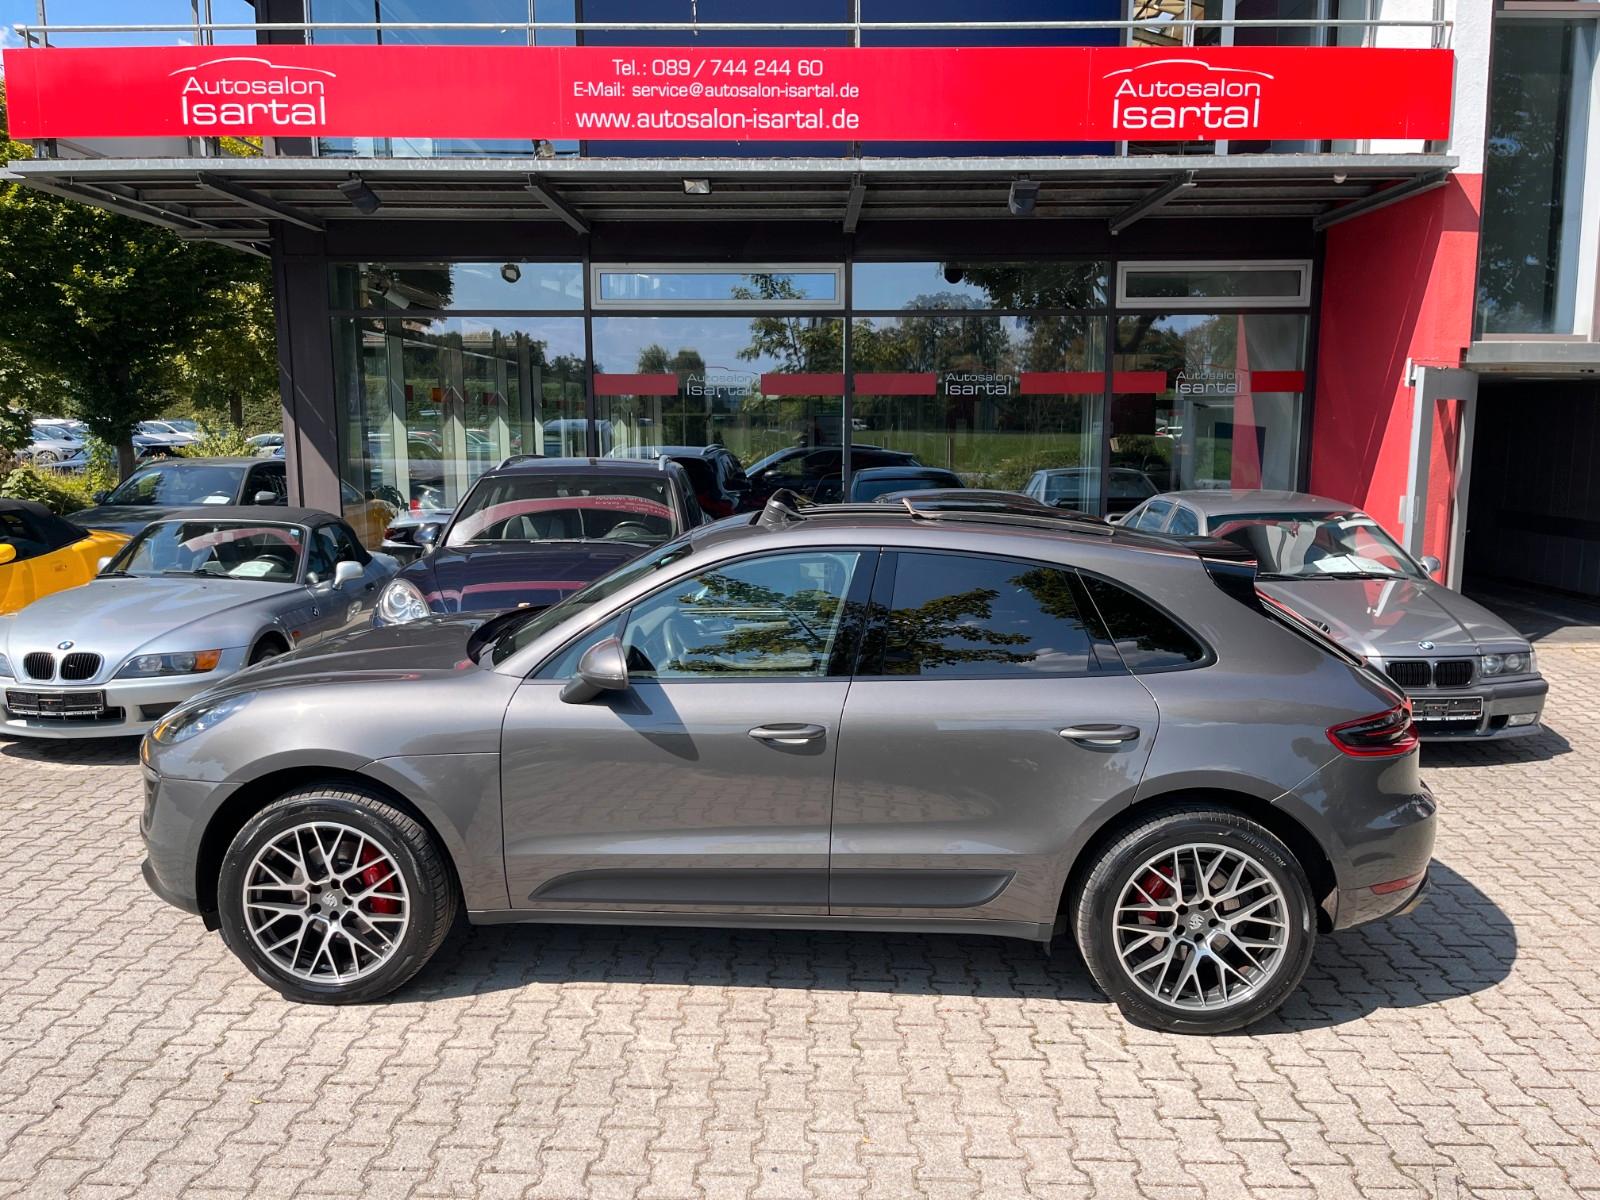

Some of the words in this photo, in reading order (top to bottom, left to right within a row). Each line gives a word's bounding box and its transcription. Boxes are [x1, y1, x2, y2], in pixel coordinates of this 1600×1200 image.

[612, 59, 647, 76] Tel.:
[754, 60, 792, 76] 244
[798, 60, 824, 76] 60
[182, 76, 325, 95] Autosalon
[573, 82, 625, 97] E-Mail:
[632, 82, 860, 98] service@autosalon-isartal.de
[1114, 78, 1261, 97] Autosalon
[181, 96, 326, 125] Isartal
[575, 107, 860, 129] www.autosalon-isartal.de
[1112, 98, 1260, 129] Isartal
[945, 372, 1013, 382] Autosalon
[686, 382, 752, 396] Isartal
[945, 382, 1012, 396] Isartal
[1175, 380, 1243, 394] Isartal
